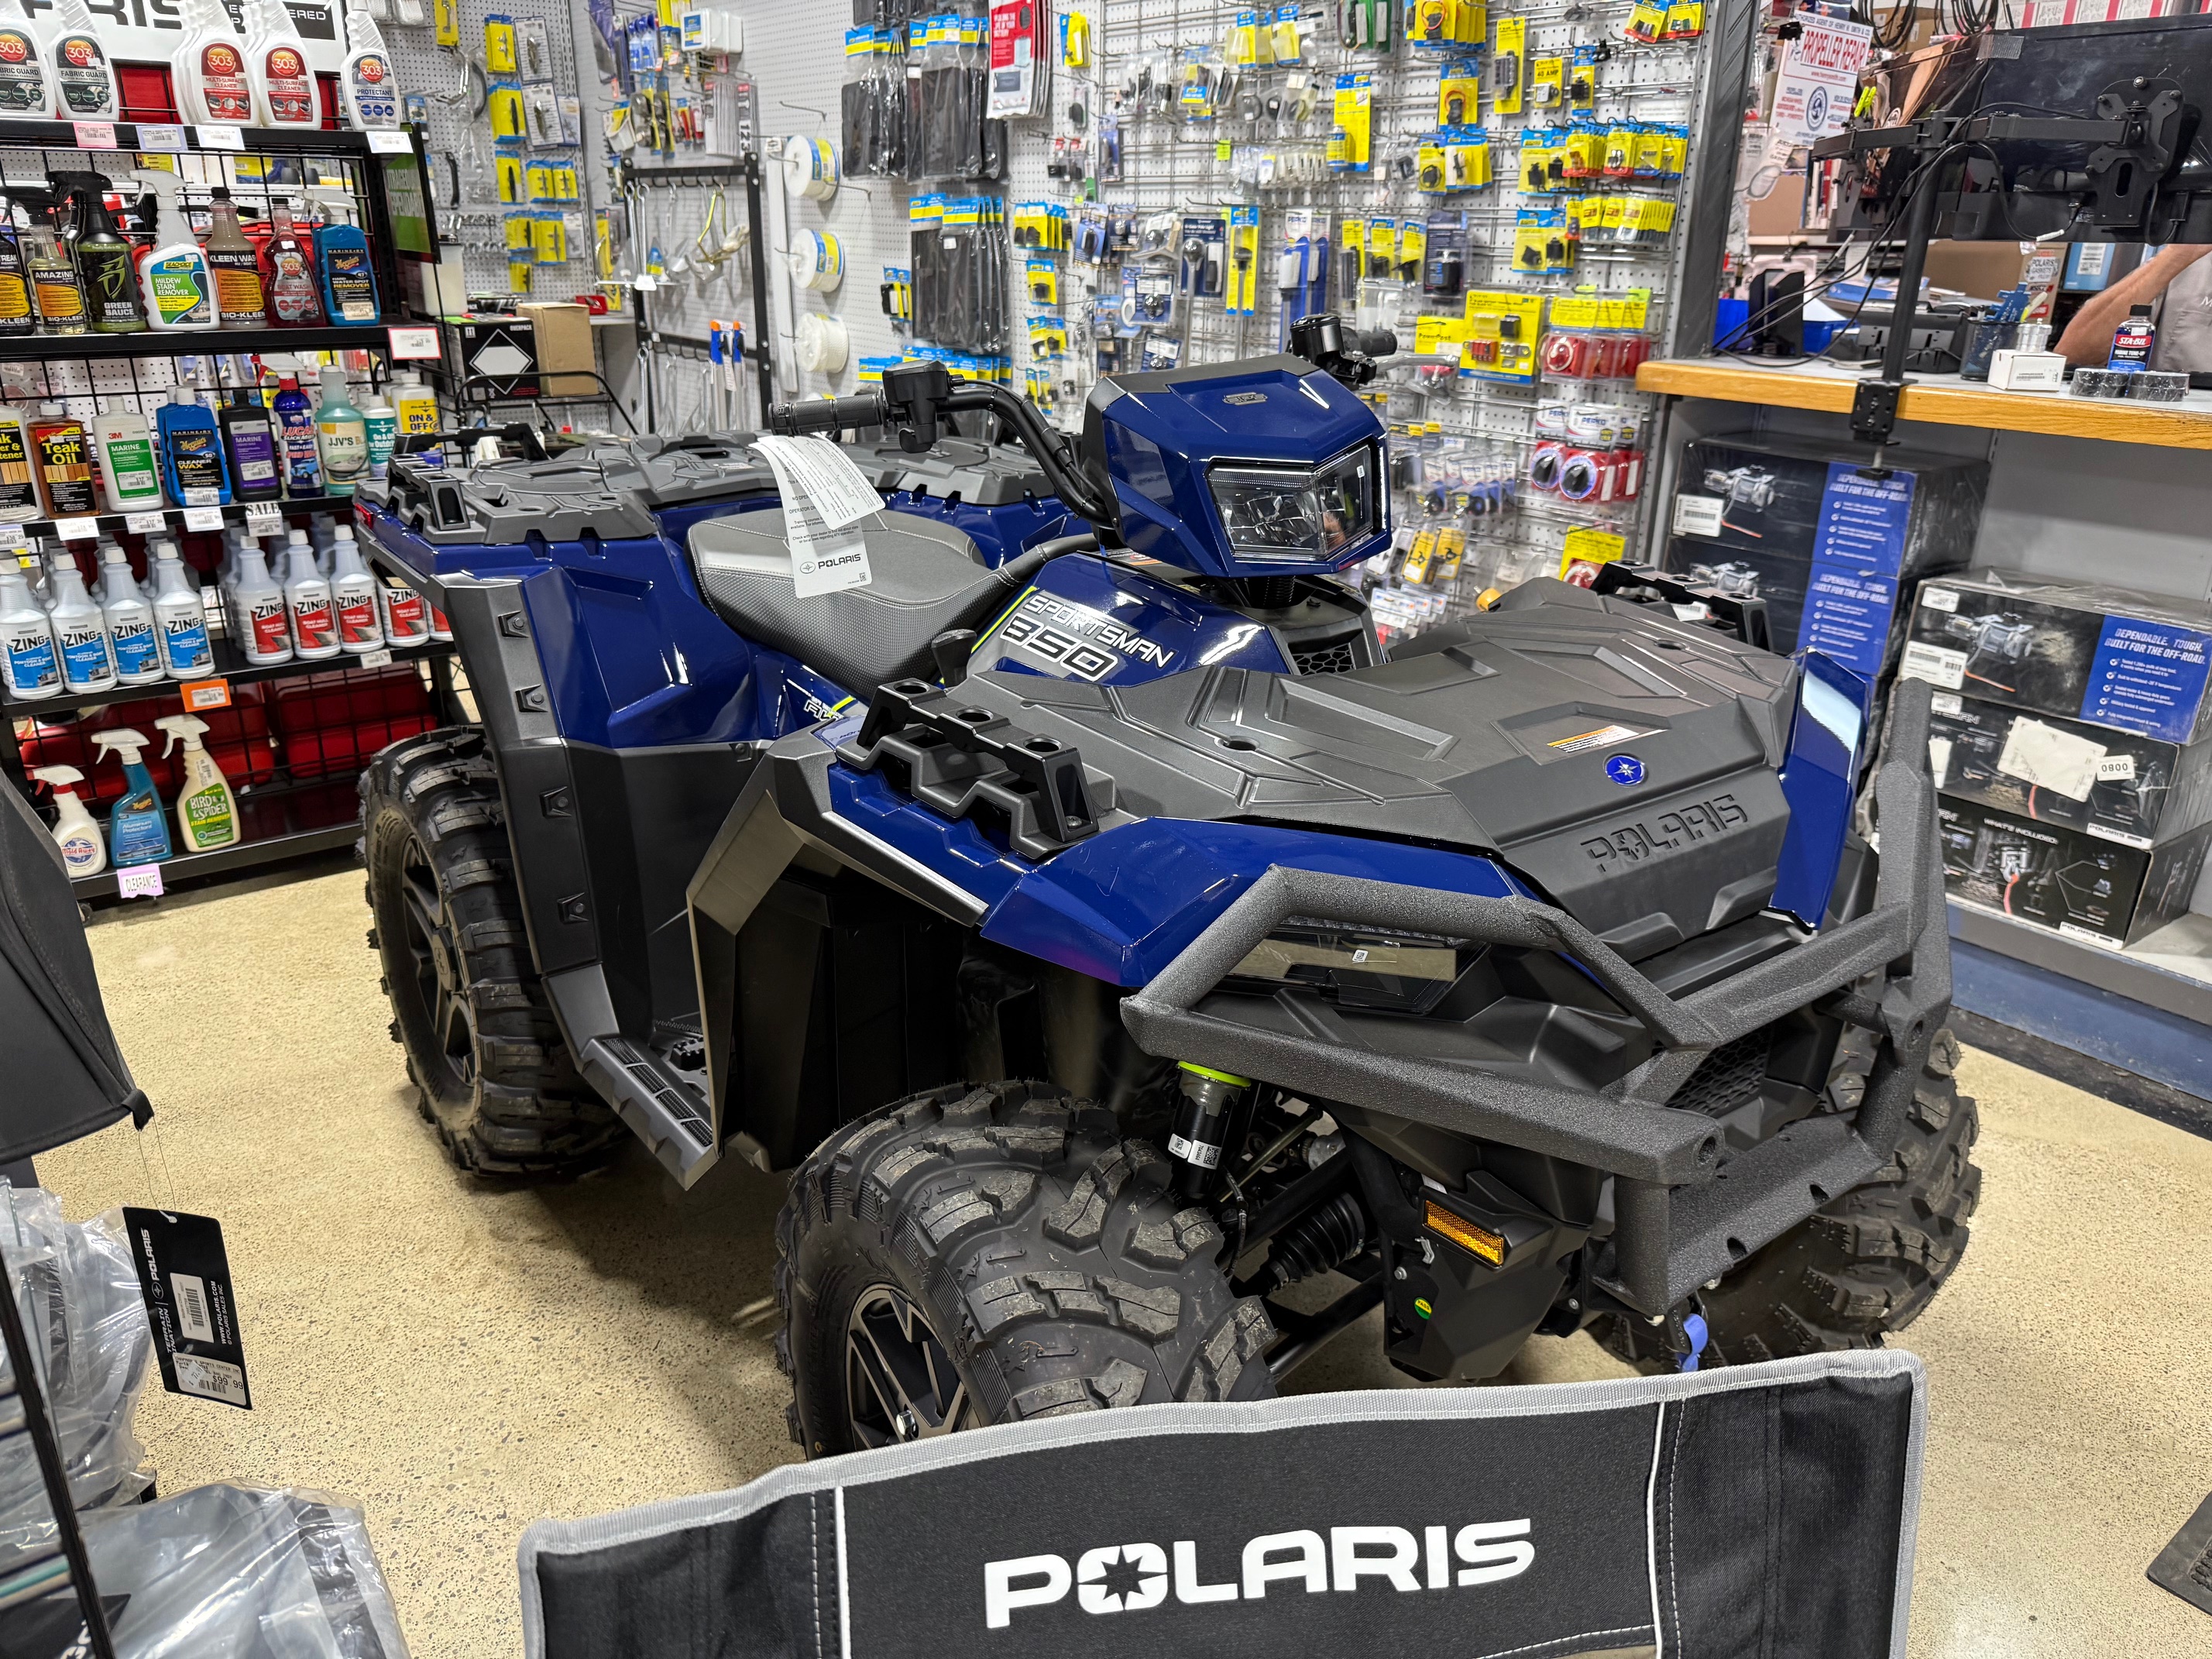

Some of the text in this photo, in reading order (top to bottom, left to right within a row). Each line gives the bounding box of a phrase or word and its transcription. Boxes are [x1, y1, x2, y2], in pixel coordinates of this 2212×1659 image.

[68, 48, 92, 58] 303
[1800, 29, 1867, 73] PROPELLER REPAIR
[210, 56, 233, 67] 303
[275, 59, 297, 70] 303
[362, 65, 382, 75] 303
[2118, 337, 2147, 345] STA-BIL
[410, 422, 428, 431] OFF
[1582, 417, 1606, 426] PERKO
[42, 441, 81, 454] Teak
[328, 437, 353, 446] JJV'S
[52, 453, 77, 465] Oil
[1848, 486, 1862, 495] FOR
[1862, 487, 1875, 497] THE
[246, 502, 280, 517] SALE
[818, 553, 861, 569] POLARIS
[297, 599, 326, 615] ZING
[338, 595, 366, 610] ZING
[256, 603, 283, 619] ZING
[114, 623, 146, 640] ZING
[168, 617, 200, 634] ZING
[1025, 595, 1177, 668] SPORTSMAN
[11, 635, 46, 653] ZING
[64, 630, 96, 647] ZING
[2114, 628, 2203, 652] DEPENDABLE. TOUGH.
[1000, 613, 1118, 682] 850
[2104, 637, 2206, 665] BUILT FOR THE OFF-ROAD.
[190, 795, 212, 809] BIRD
[198, 803, 228, 820] SPIDER
[1984, 817, 2014, 833] WHAT'S
[2089, 824, 2125, 839] POLARIS
[1580, 794, 1748, 874] POLARIS
[78, 847, 96, 855] Away
[125, 874, 158, 892] CLEARANCE
[2061, 924, 2096, 938] POLARIS
[140, 1227, 160, 1281] POLARIS
[210, 1280, 227, 1345] WWW.POLARIS.COM
[1417, 1300, 1431, 1310] PASS
[157, 1307, 171, 1354] TERRAIN
[163, 1308, 177, 1354] INATION
[984, 1517, 1535, 1630] POLARIS
